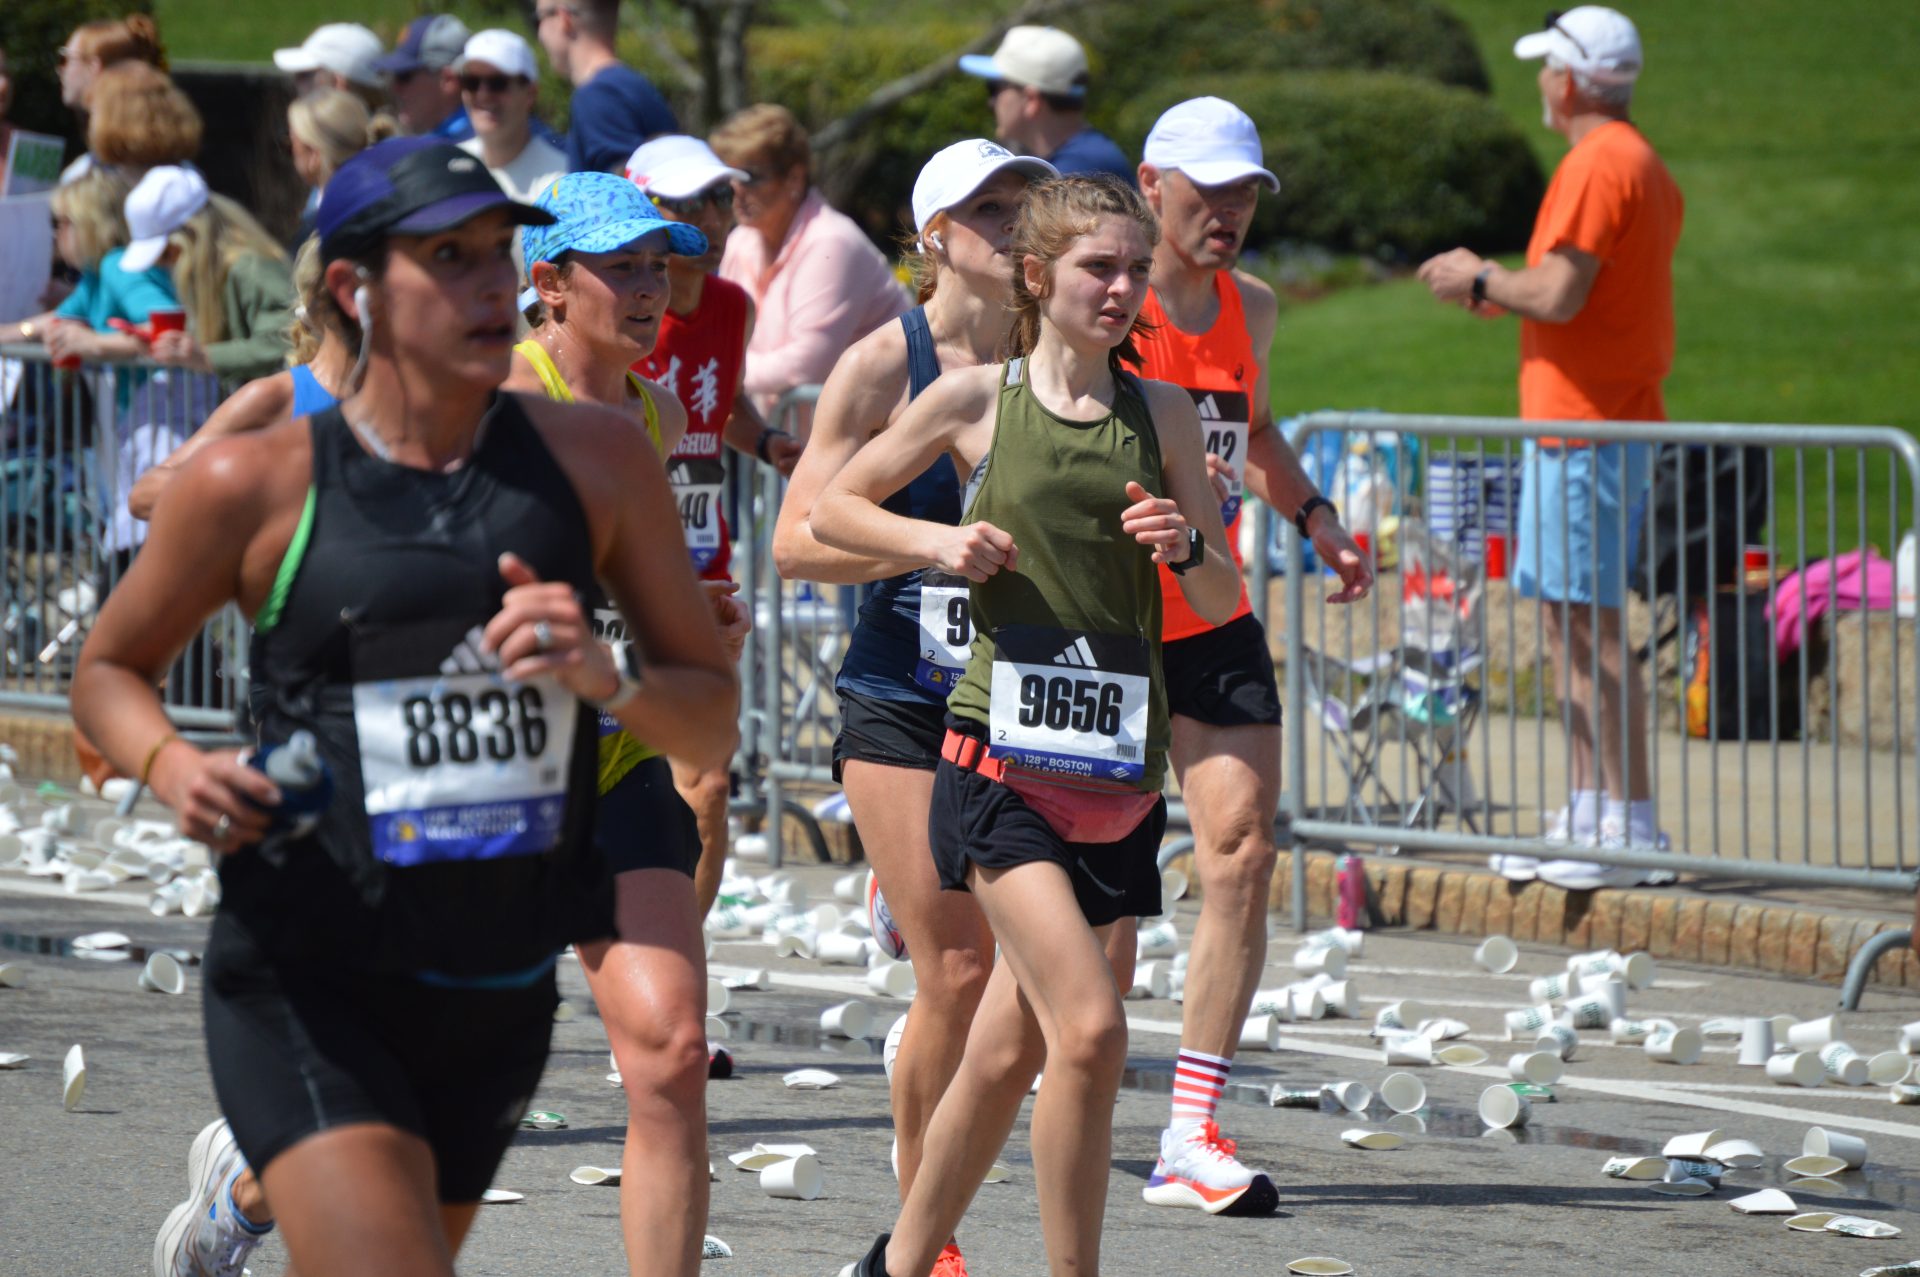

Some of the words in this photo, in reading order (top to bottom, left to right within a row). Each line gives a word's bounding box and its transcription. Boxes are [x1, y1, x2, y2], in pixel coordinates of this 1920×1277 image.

[672, 433, 717, 455] GHUA
[674, 492, 710, 529] 40
[927, 649, 936, 661] 2
[1019, 674, 1123, 736] 9656
[403, 687, 547, 766] 8836
[997, 730, 1008, 741] 2
[1049, 757, 1093, 771] BOSTON
